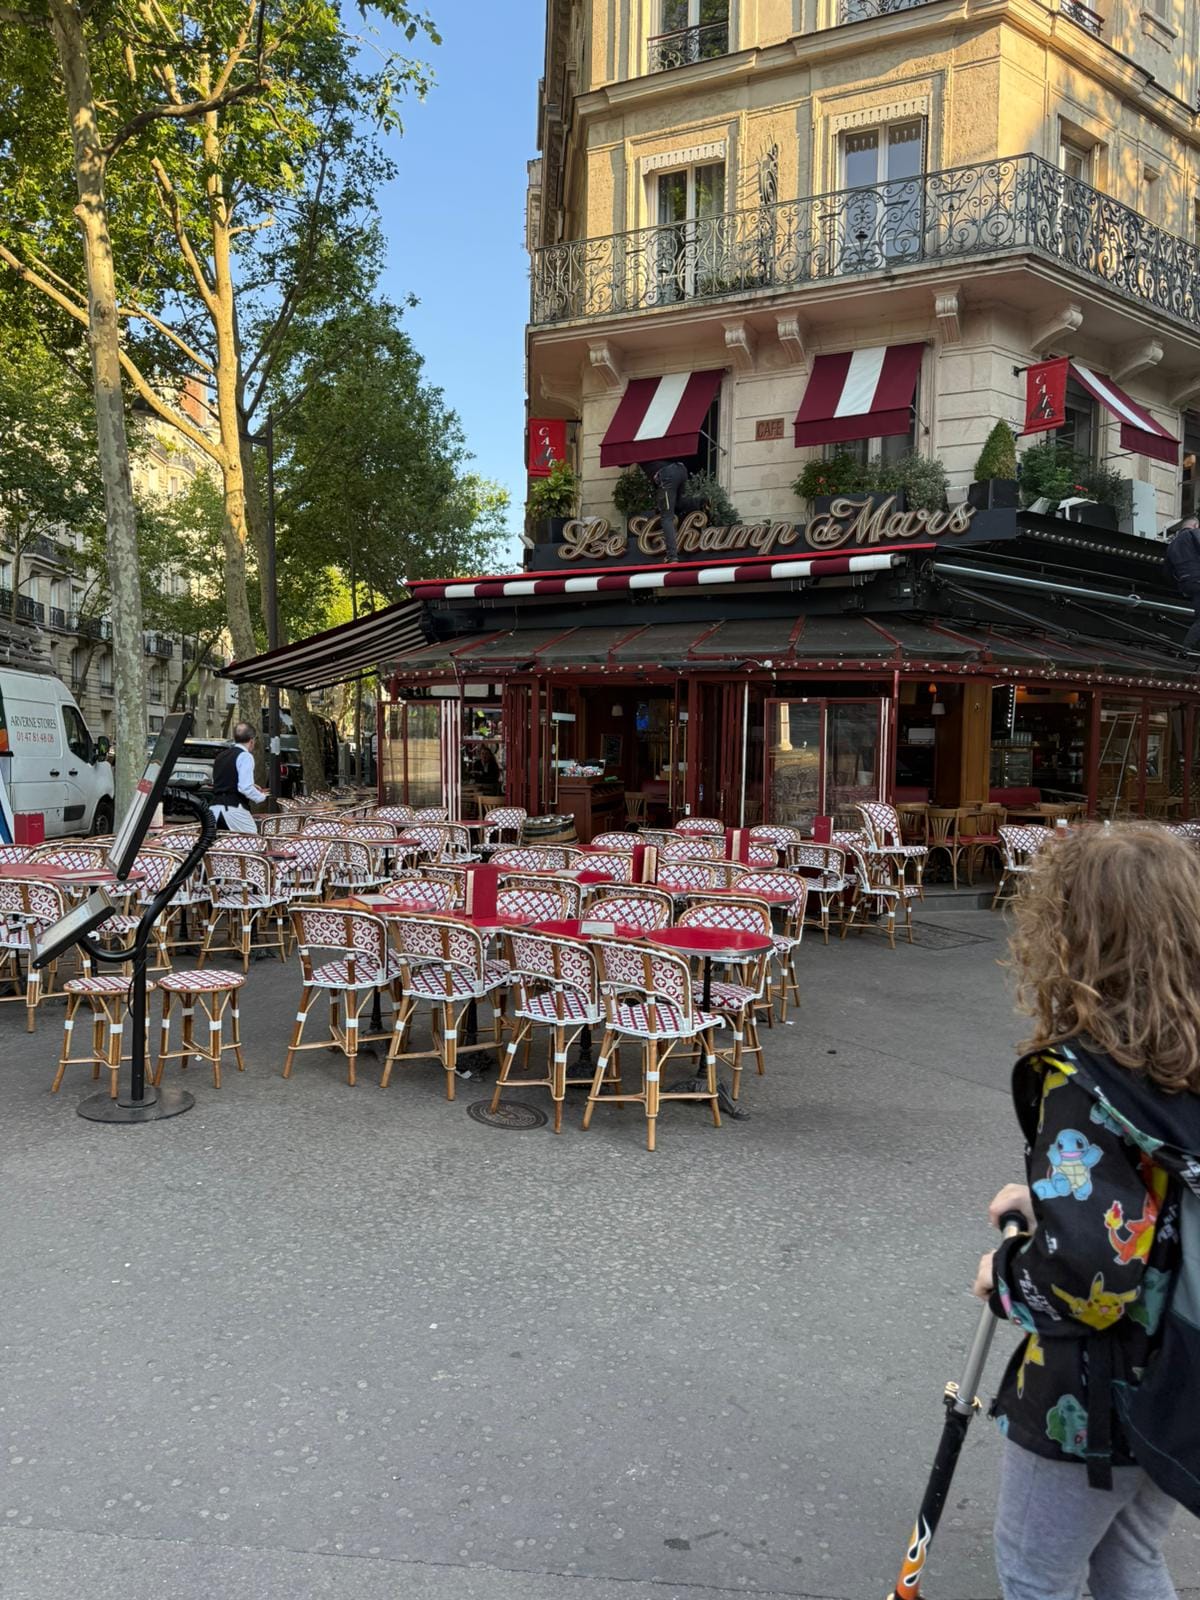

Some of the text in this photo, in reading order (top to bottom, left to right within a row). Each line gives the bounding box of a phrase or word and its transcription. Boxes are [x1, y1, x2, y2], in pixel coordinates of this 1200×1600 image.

[557, 495, 977, 560] Le Champ de Mars
[36, 717, 57, 729] STORES
